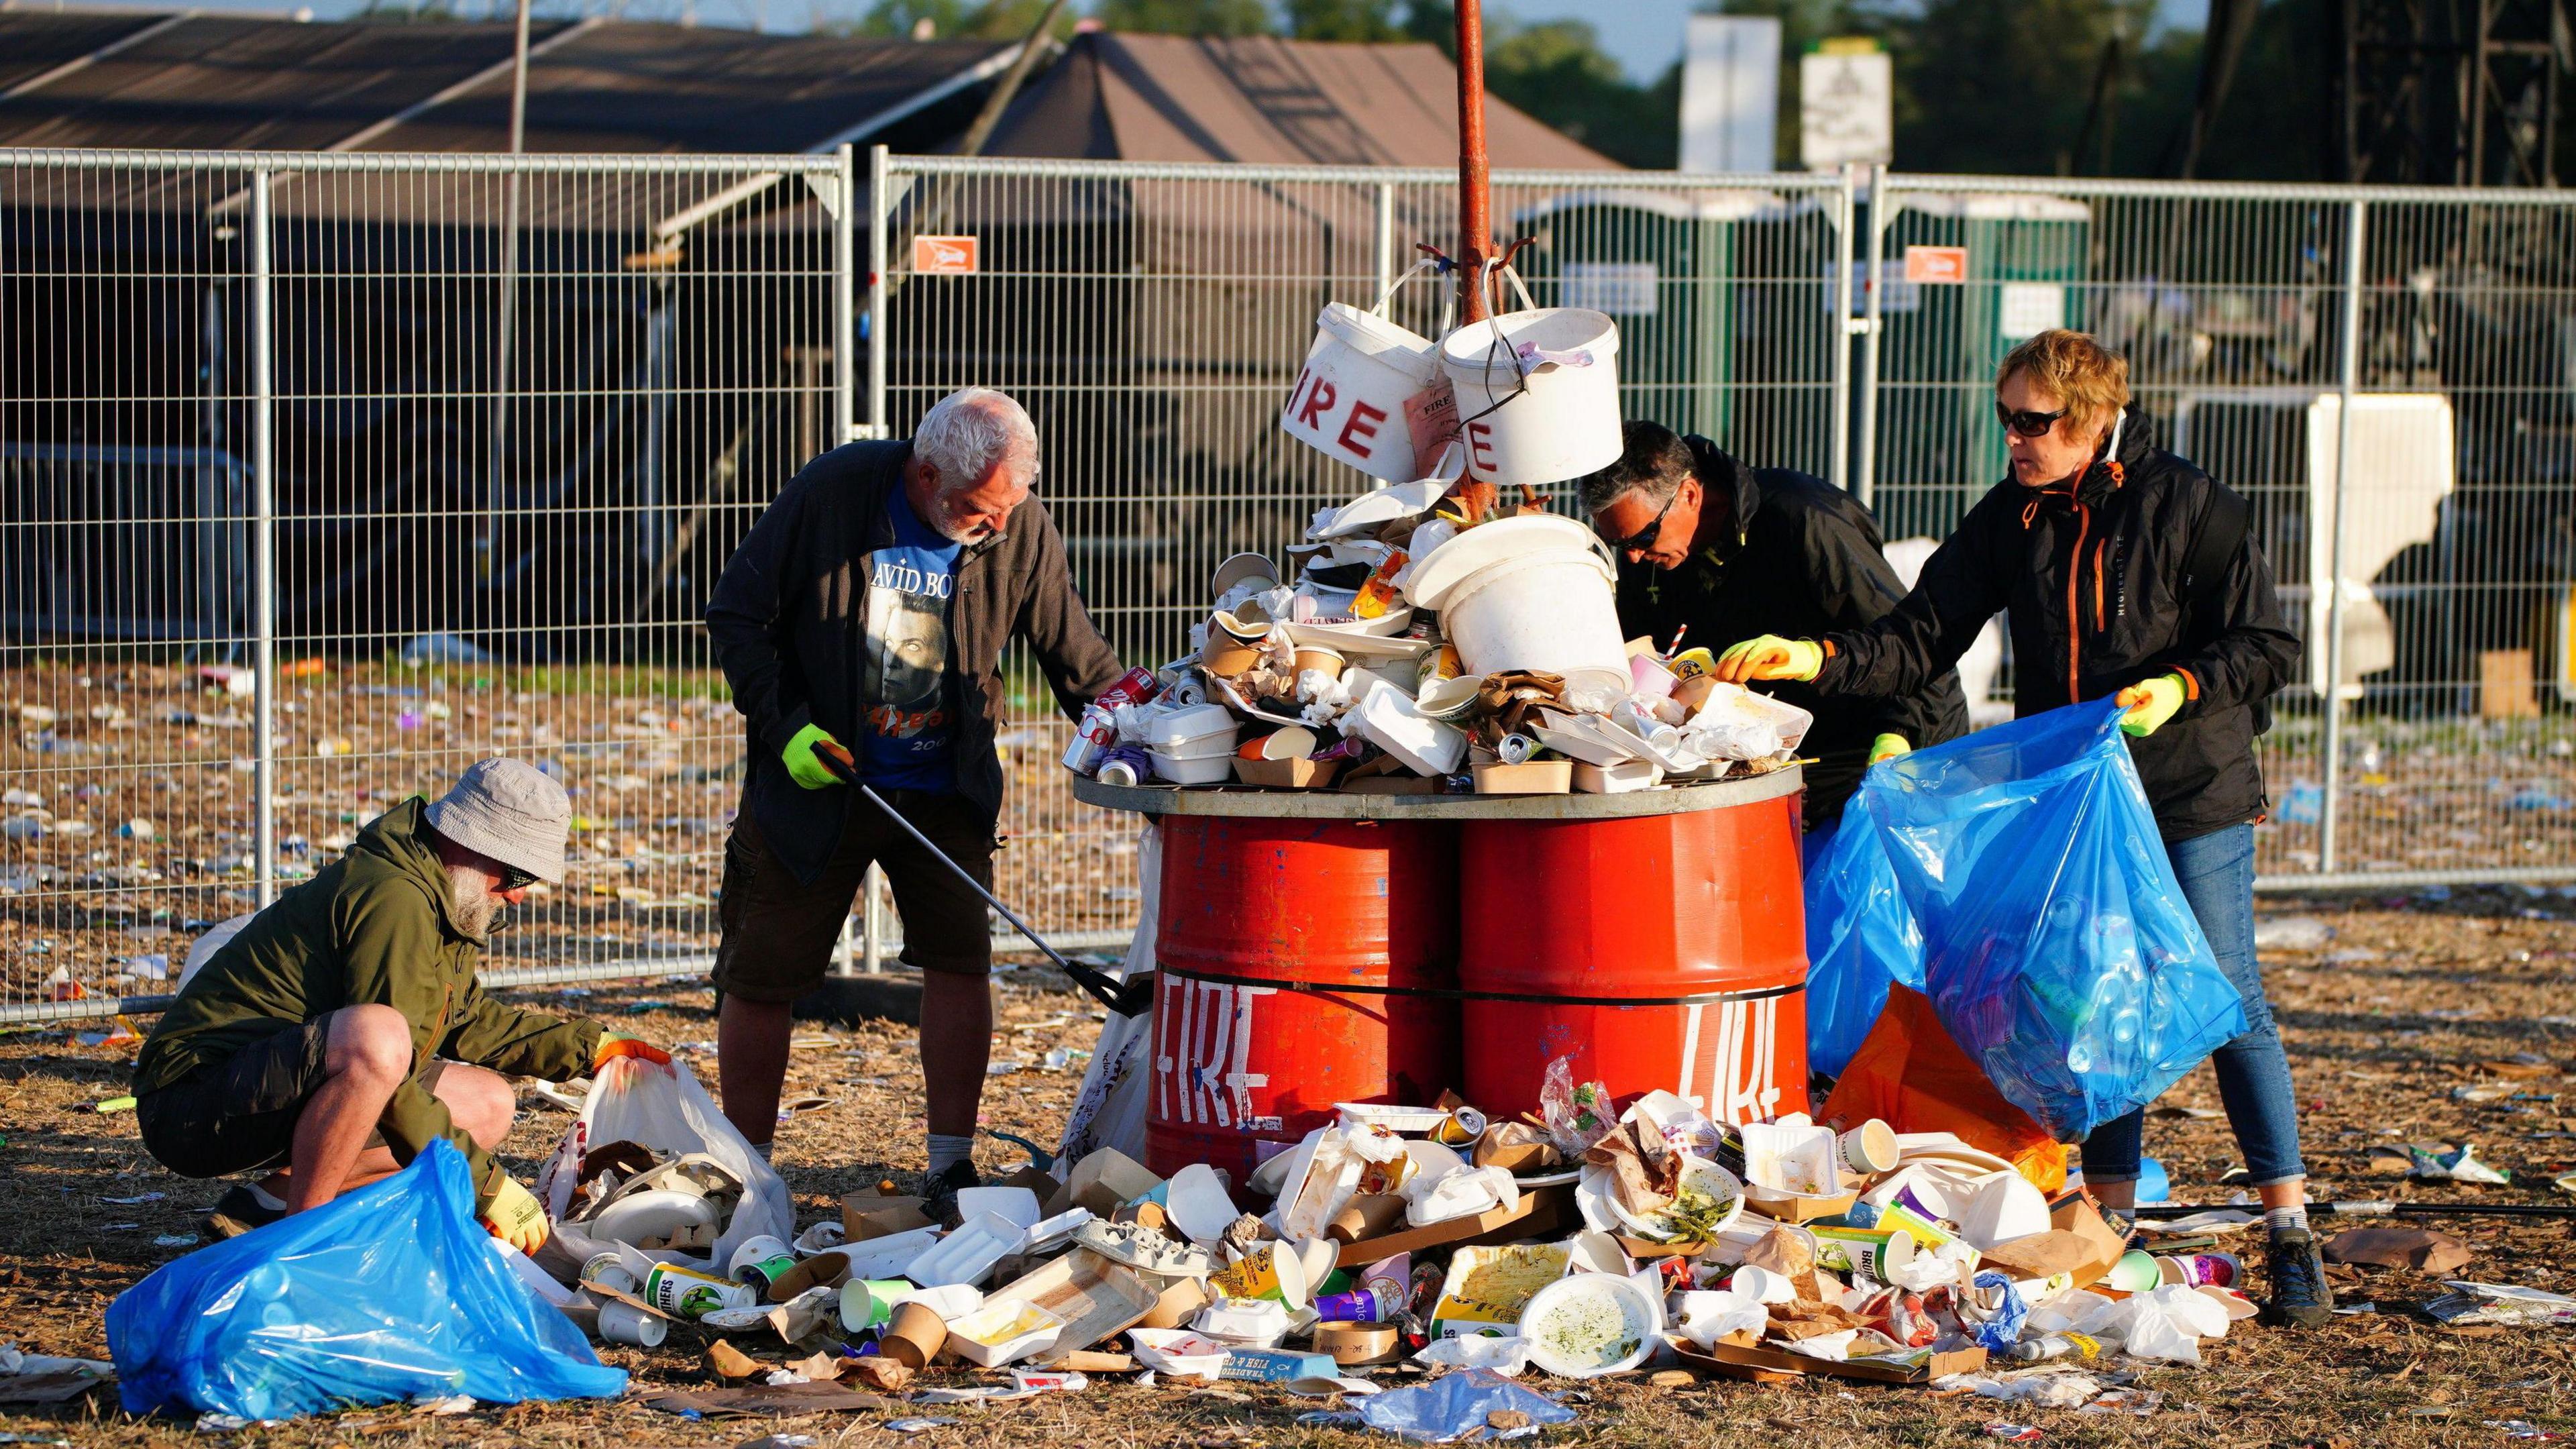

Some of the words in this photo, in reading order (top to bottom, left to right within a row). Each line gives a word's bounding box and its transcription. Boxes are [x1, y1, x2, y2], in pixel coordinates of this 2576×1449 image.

[1424, 395, 1451, 415] FIRE
[923, 570, 957, 600] BO
[1157, 973, 1283, 1130] FIRE
[1355, 1296, 1367, 1322] enjo
[1238, 1357, 1246, 1366] &
[1246, 1358, 1271, 1369] FISH
